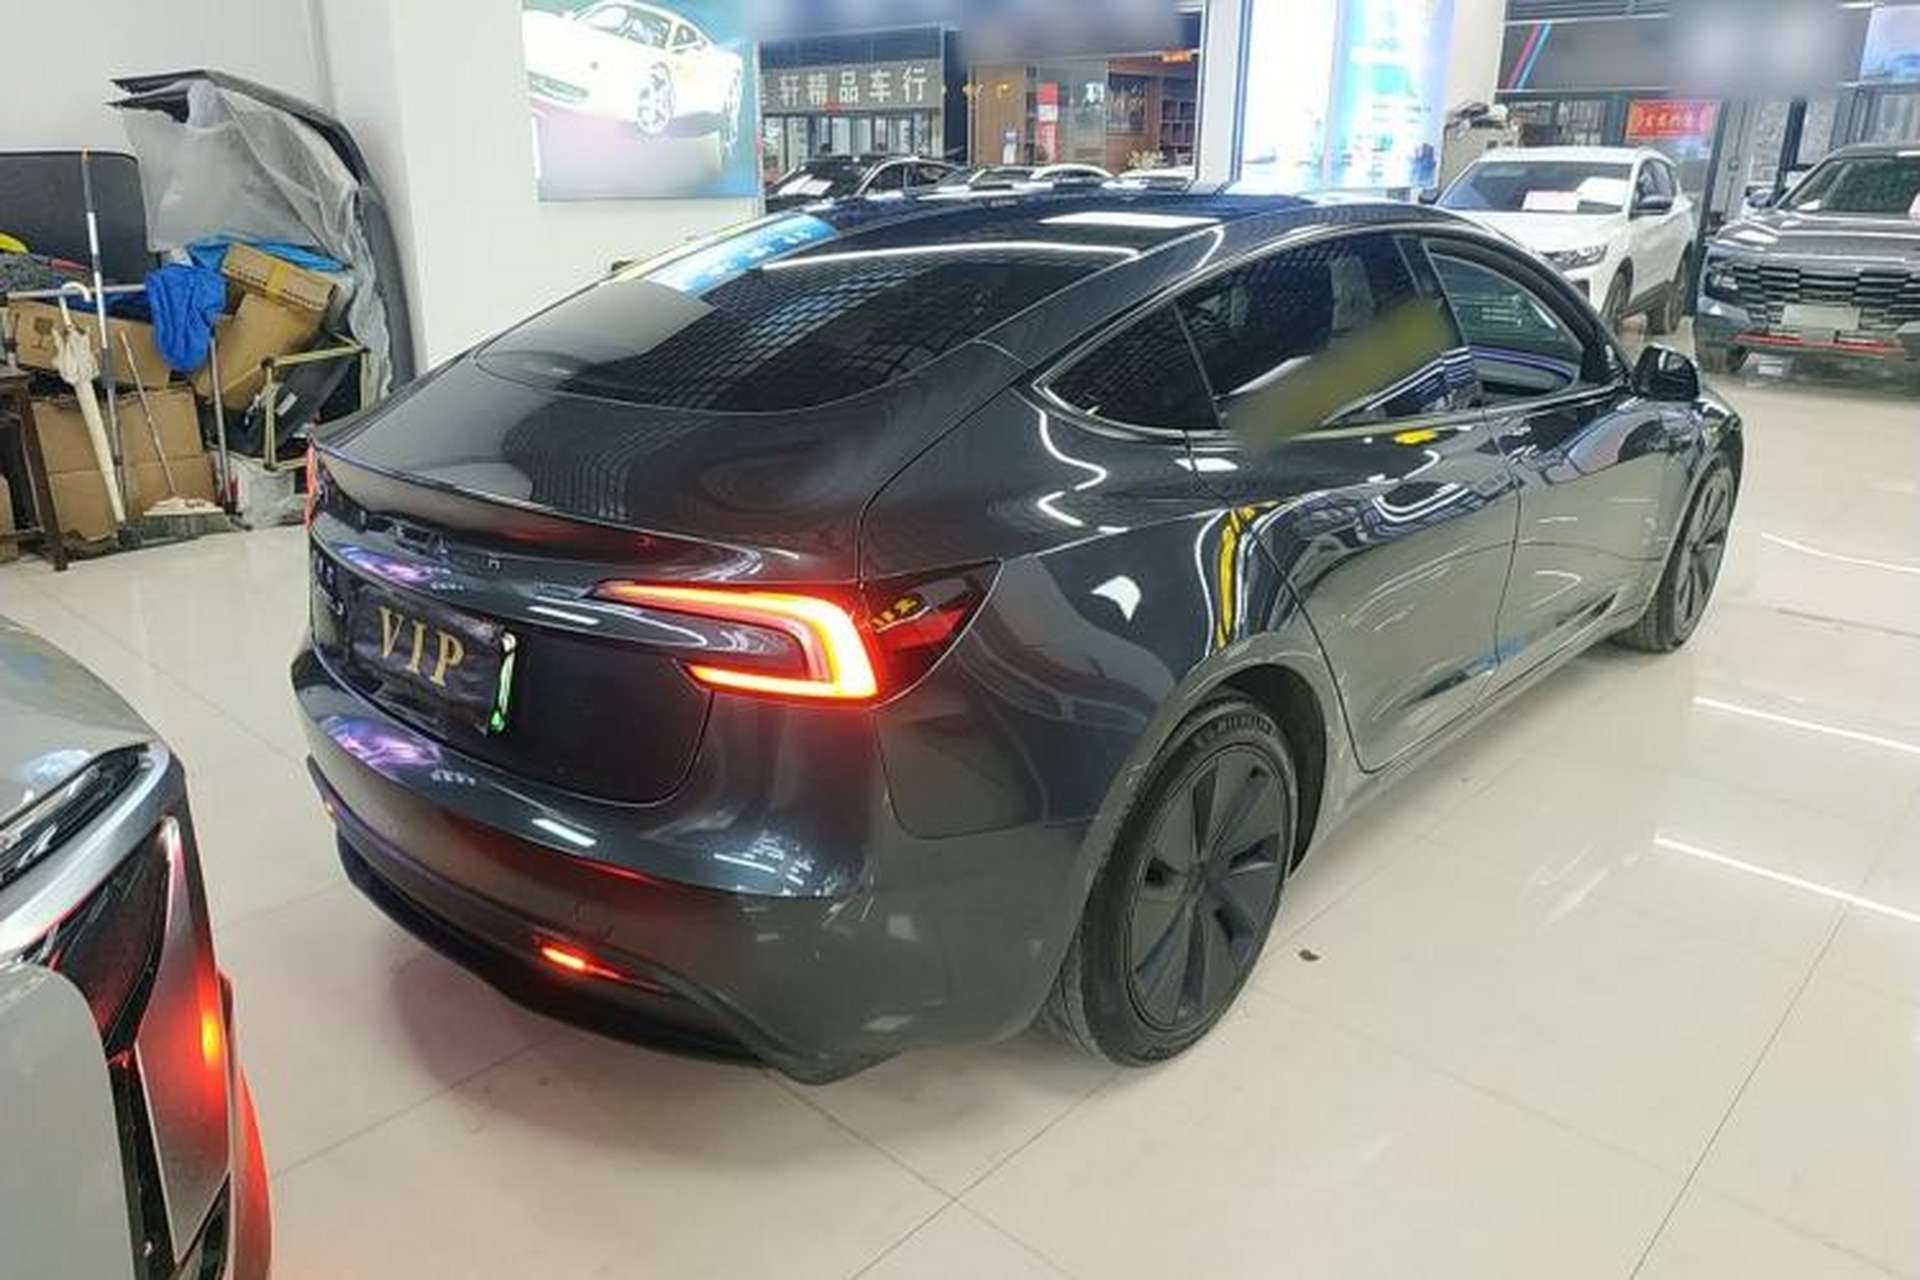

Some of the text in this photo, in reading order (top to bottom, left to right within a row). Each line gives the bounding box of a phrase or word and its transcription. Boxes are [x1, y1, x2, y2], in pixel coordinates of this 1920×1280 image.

[761, 66, 927, 107] 轩精品车行
[378, 606, 464, 687] VIP
